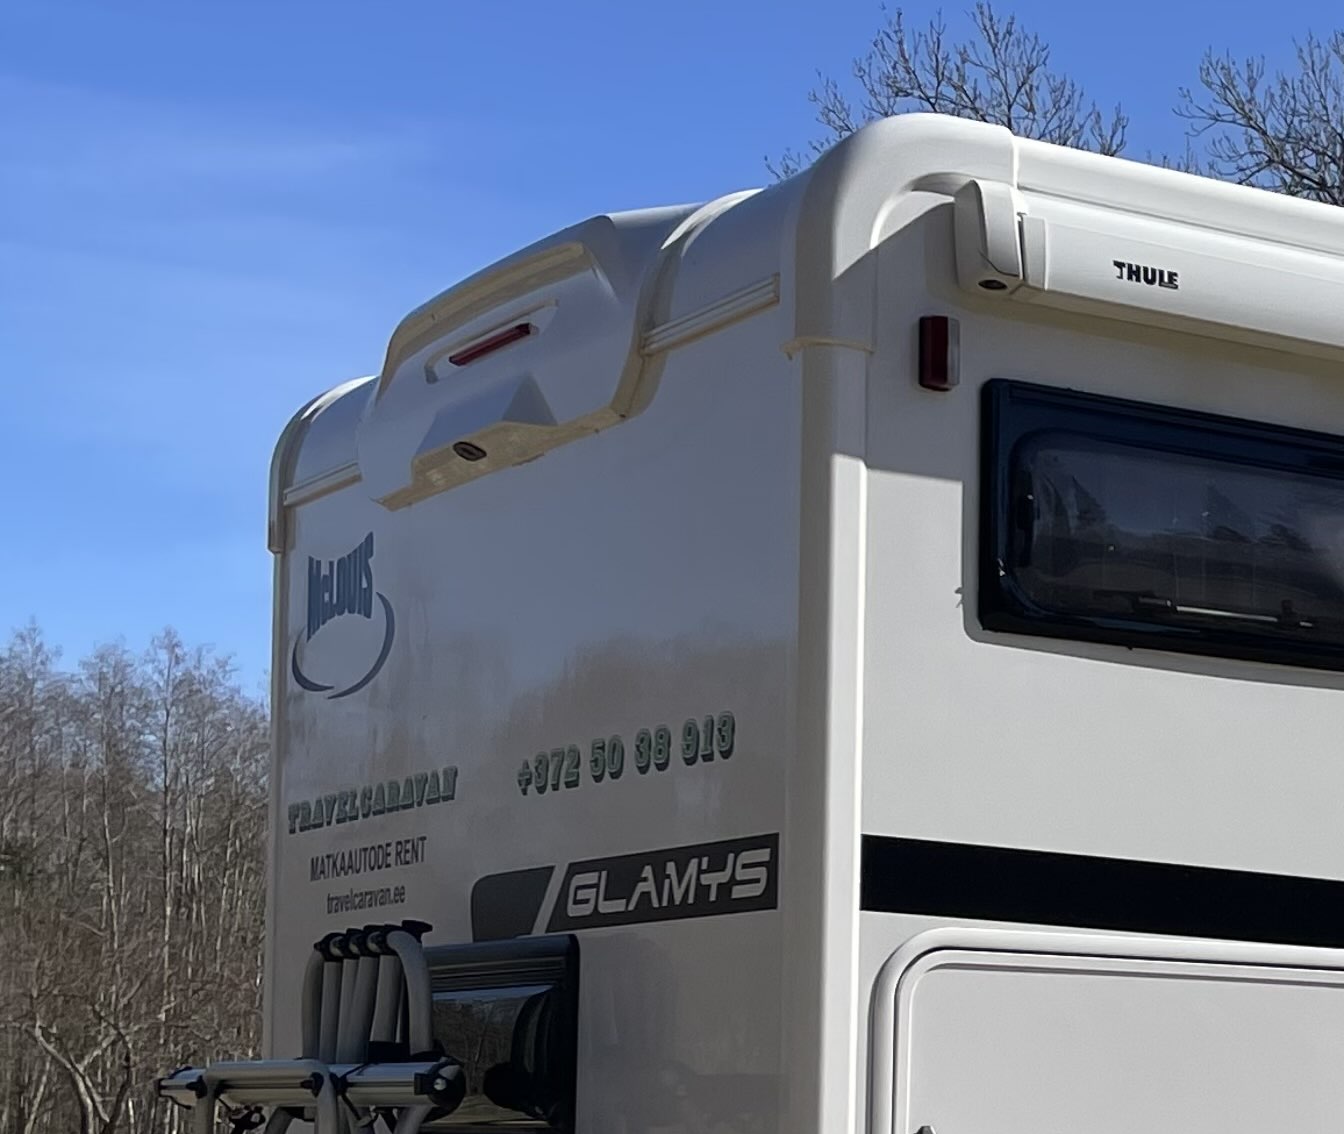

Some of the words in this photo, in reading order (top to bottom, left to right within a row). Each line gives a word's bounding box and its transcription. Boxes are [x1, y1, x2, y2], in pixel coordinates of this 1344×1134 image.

[1113, 260, 1179, 290] THULE
[517, 743, 581, 797] +372
[590, 734, 625, 784] 50
[634, 724, 672, 776] 38
[681, 709, 736, 767] 913
[288, 765, 458, 835] TRAVELCARAVAN
[310, 842, 393, 882] MATKAAUTODE
[395, 836, 427, 867] RENT
[566, 847, 772, 918] GLAMYS
[327, 885, 406, 915] travelcaravan.ee
